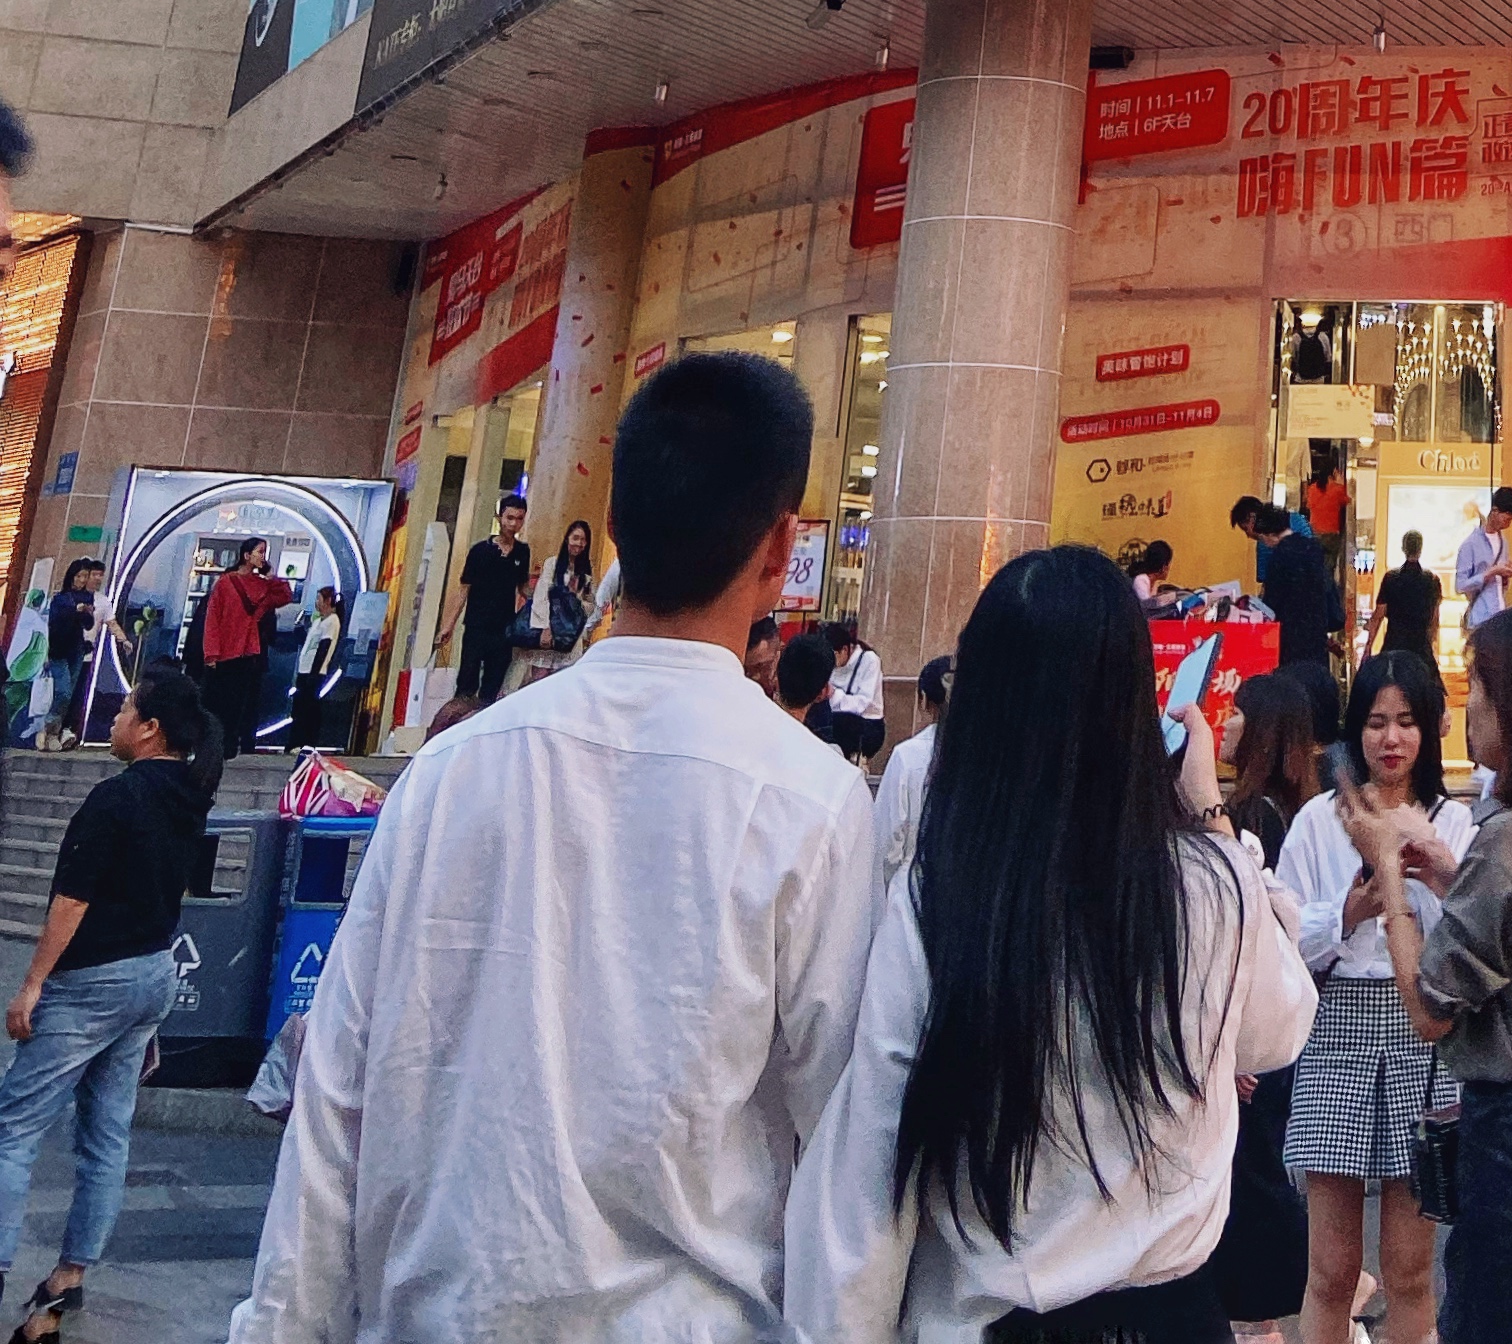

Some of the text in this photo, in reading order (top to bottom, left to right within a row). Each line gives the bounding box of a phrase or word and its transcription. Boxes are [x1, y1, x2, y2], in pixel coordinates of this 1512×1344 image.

[1241, 67, 1471, 141] 20周年庆
[1236, 134, 1470, 219] 嗨FUN篇
